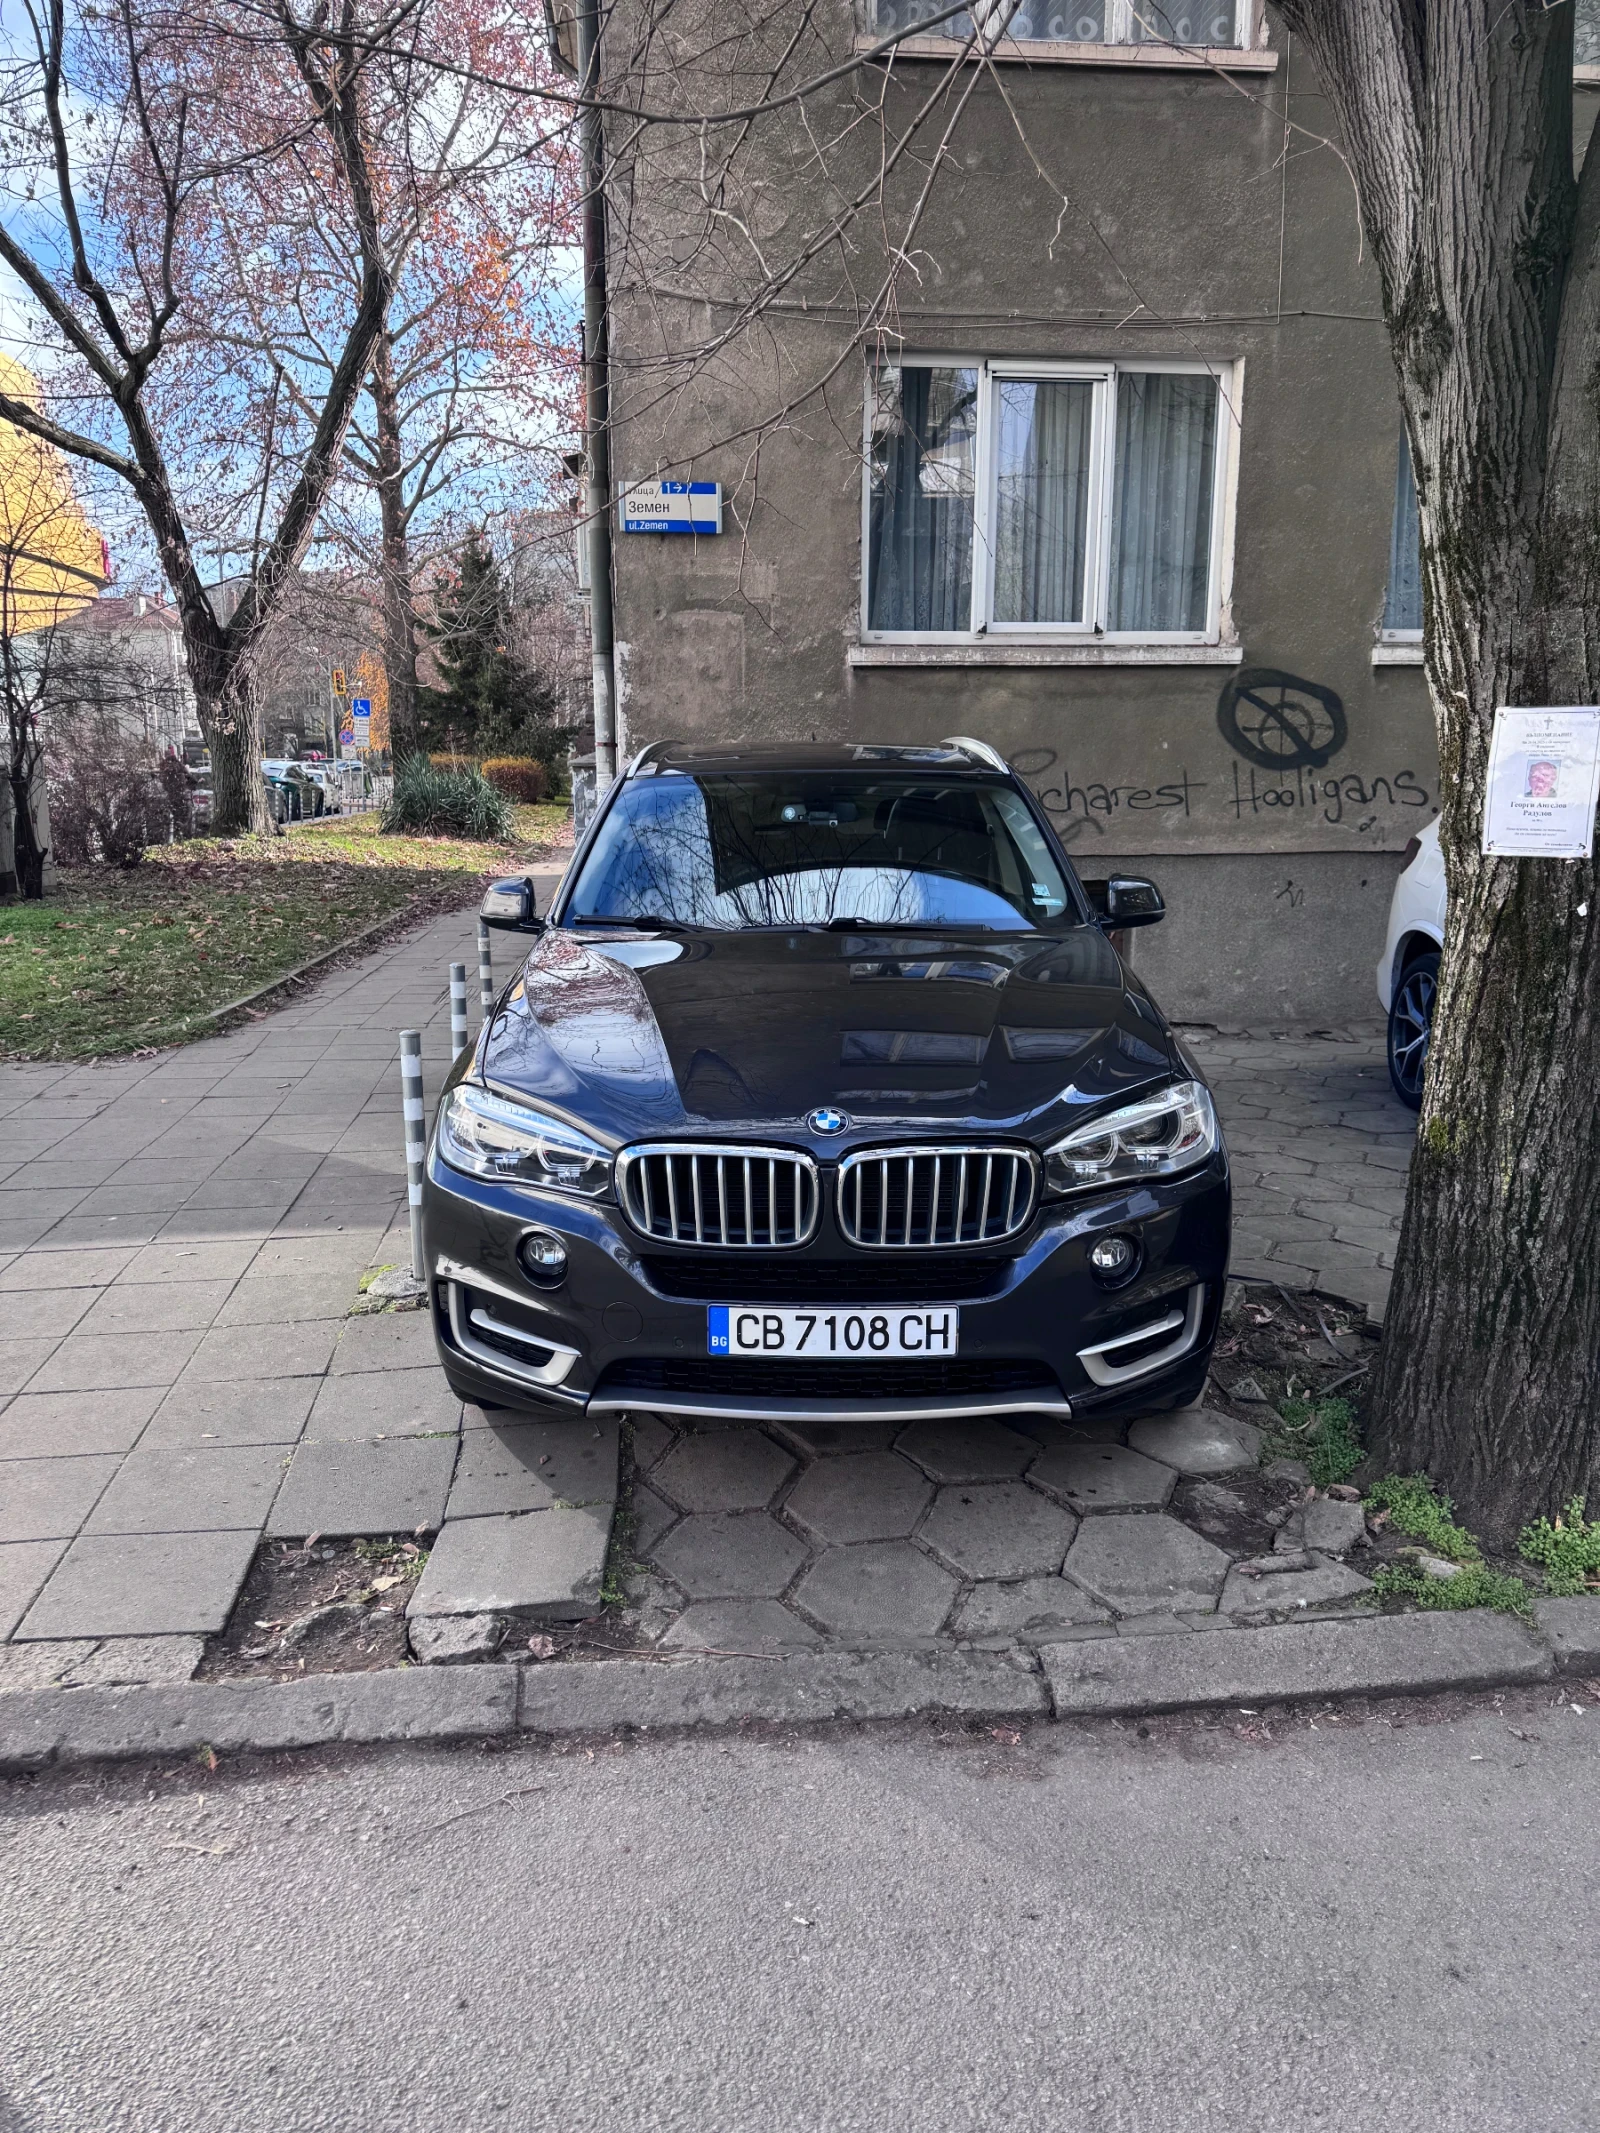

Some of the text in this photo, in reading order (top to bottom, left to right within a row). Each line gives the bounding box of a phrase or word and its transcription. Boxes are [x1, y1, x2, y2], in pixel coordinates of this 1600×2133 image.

[628, 500, 670, 513] Земен
[628, 520, 669, 530] ul.Zemen
[1036, 767, 1208, 817] charest
[1510, 801, 1535, 809] Георги
[711, 1335, 728, 1347] BG
[795, 1315, 890, 1351] 7108
